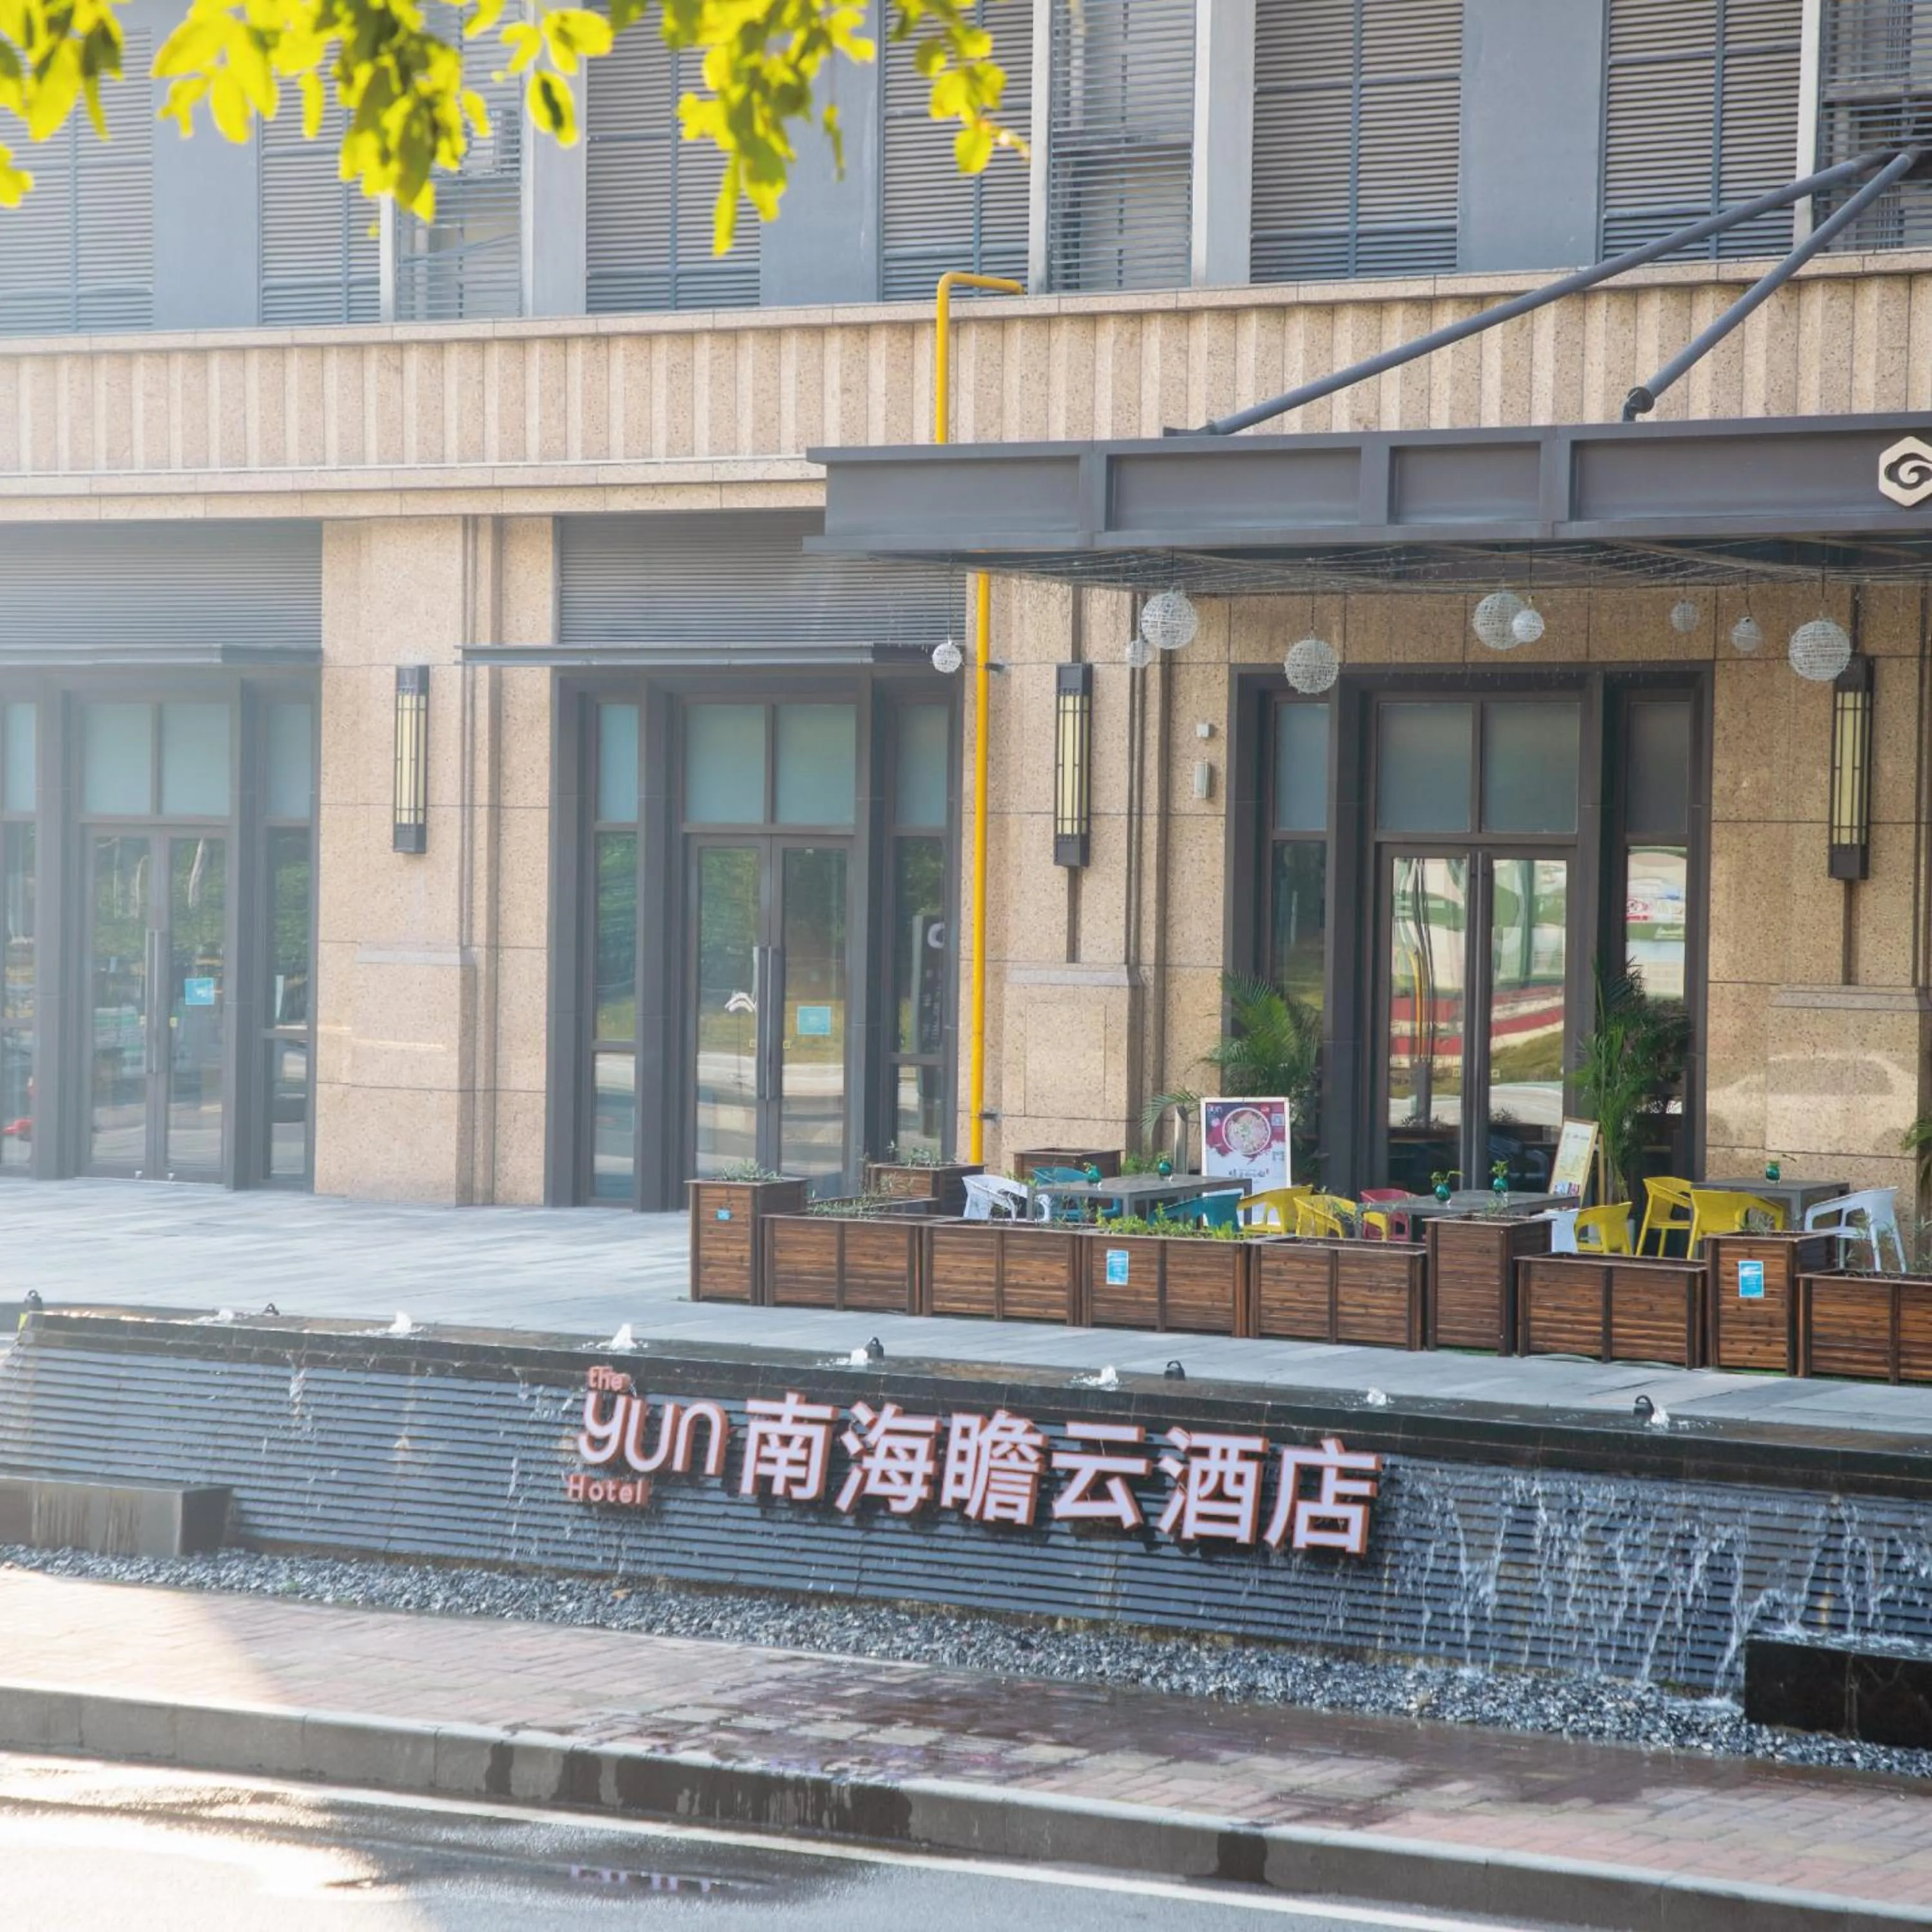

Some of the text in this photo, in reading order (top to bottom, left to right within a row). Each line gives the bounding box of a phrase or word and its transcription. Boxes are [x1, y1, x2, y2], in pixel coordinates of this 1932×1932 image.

[589, 1366, 630, 1392] the
[578, 1391, 728, 1476] yun
[568, 1473, 649, 1507] Hotel
[741, 1390, 1382, 1554] 南海瞻云酒店
